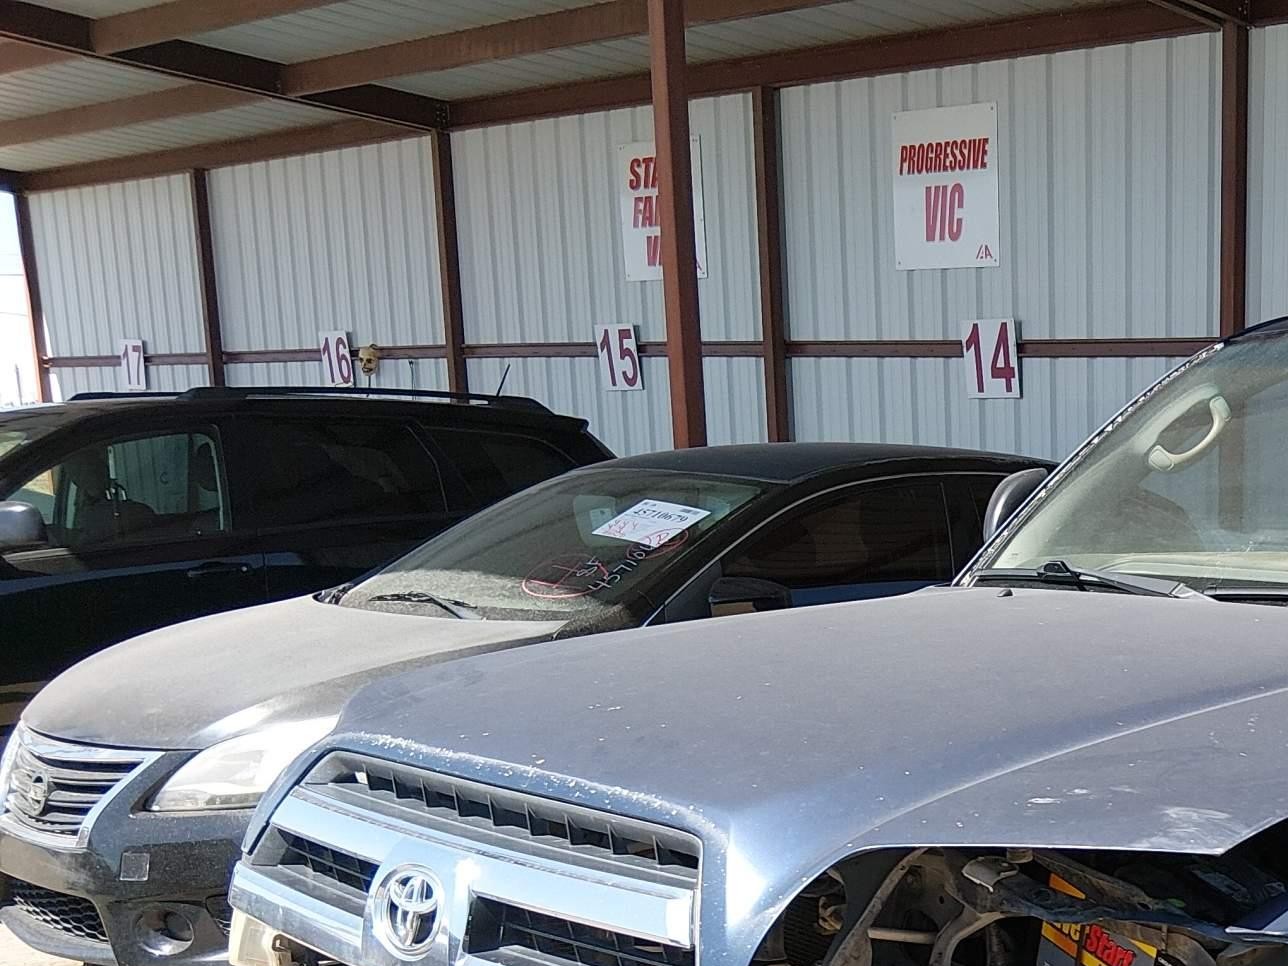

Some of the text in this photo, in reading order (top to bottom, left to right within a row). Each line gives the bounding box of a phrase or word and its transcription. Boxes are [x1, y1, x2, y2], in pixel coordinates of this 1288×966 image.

[629, 157, 658, 190] STA
[899, 138, 990, 176] PROGRESSIVE
[633, 196, 660, 228] FA
[925, 183, 965, 242] VIC
[121, 344, 142, 386] 17
[321, 336, 352, 384] 16
[600, 329, 638, 387] 15
[966, 322, 1015, 393] 14
